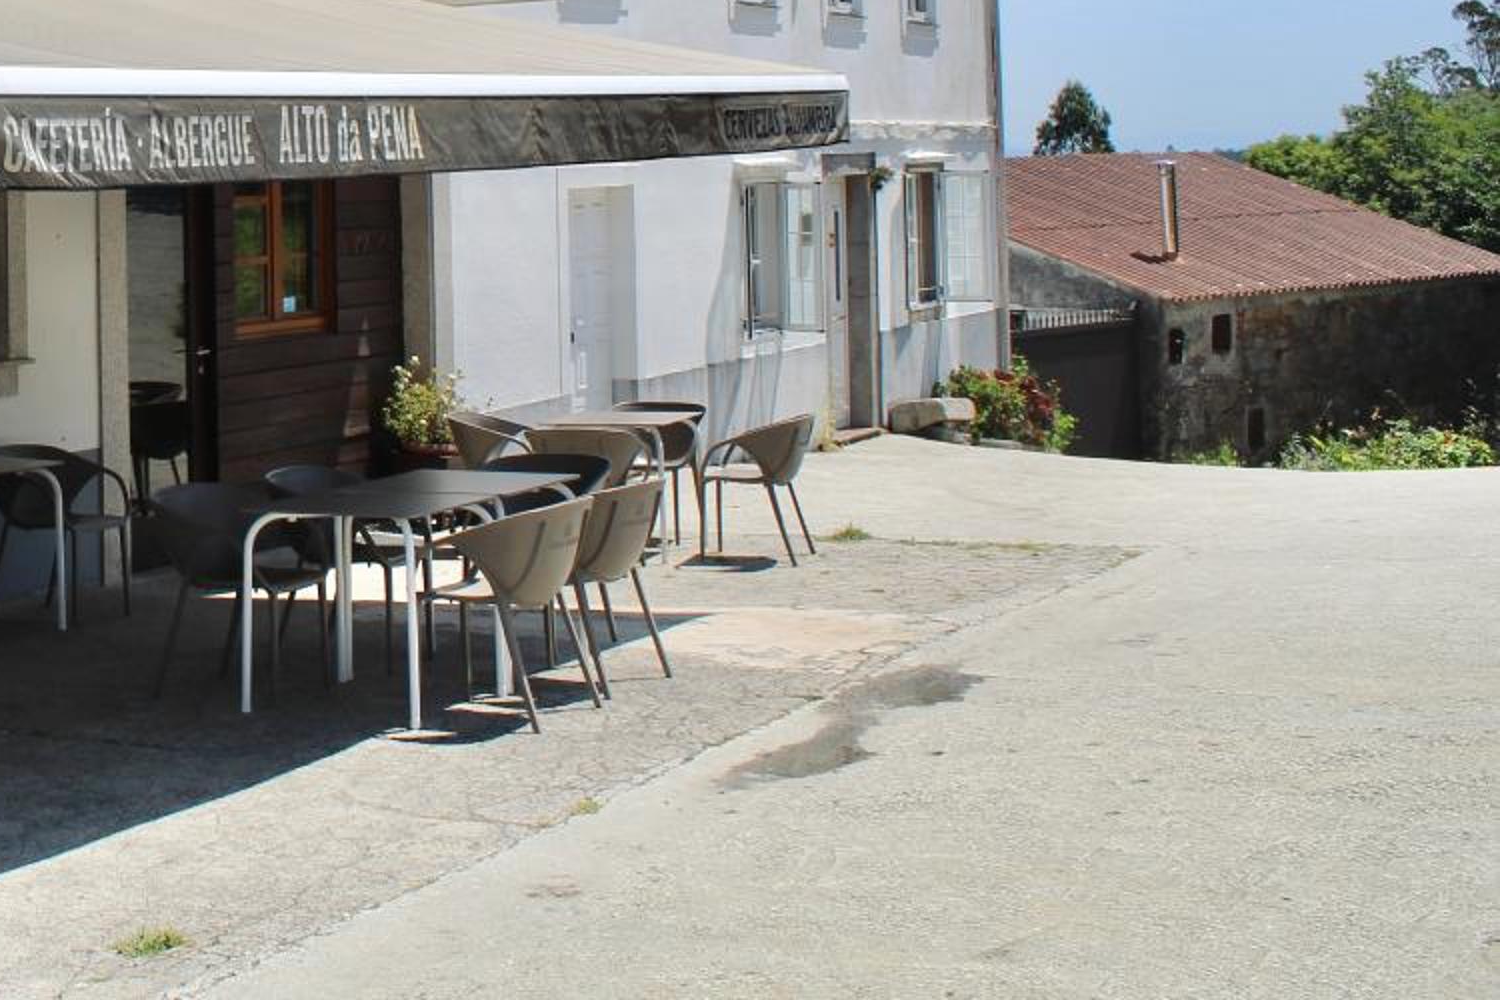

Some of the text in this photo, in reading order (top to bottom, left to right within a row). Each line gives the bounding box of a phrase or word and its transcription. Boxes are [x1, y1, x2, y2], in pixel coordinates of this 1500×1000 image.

[3, 104, 425, 173] CAFETERÍA ALBERGUE ALTO da PENA
